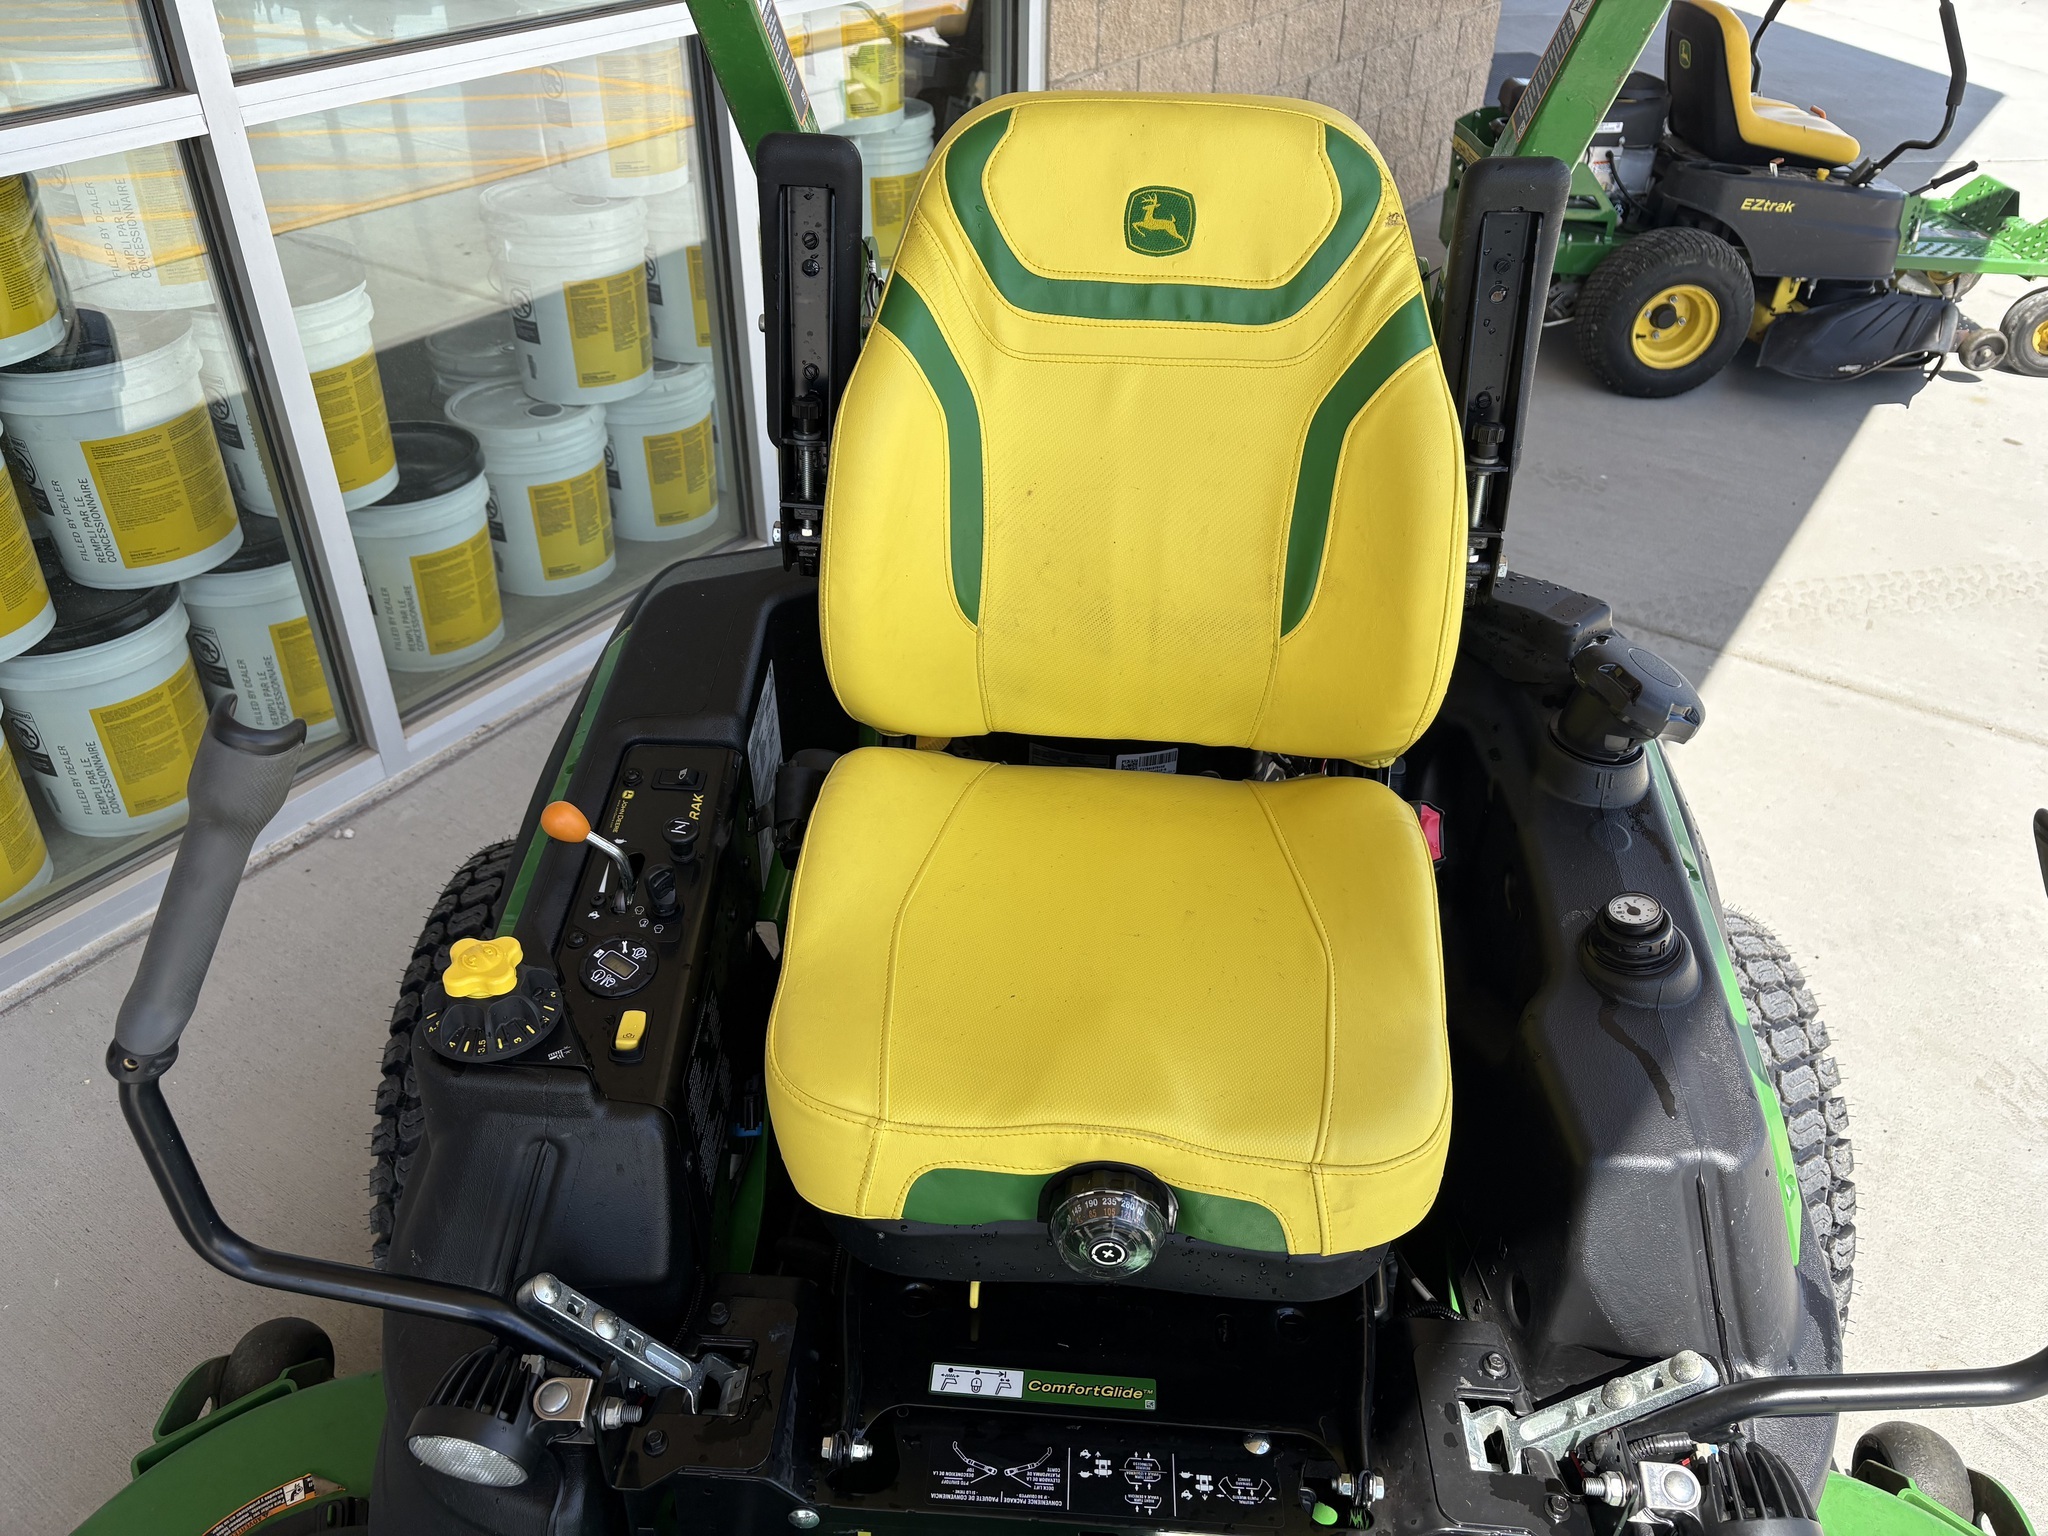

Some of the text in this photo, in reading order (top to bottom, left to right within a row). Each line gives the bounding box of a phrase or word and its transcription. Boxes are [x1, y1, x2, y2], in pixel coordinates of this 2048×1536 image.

[85, 182, 120, 278] FILLED BY DEALER
[115, 178, 152, 278] CONCESSIONNAIRE
[1740, 198, 1796, 213] EZtrak
[109, 200, 140, 278] REMPLI PAR LE
[51, 480, 90, 561] FILLED BY DEALER
[73, 497, 107, 563] REMPLI PAR LE
[78, 478, 117, 563] CONCESSIONNAIRE
[381, 587, 402, 651] FILLED BY DEALER
[398, 600, 405, 608] LE
[401, 610, 410, 624] PAR
[237, 659, 264, 726] FILLED BY DEALER
[257, 671, 266, 680] LE
[261, 683, 272, 697] PAR
[57, 745, 92, 815] FILLED BY DEALER
[80, 758, 110, 815] REMPLI PAR LE
[85, 741, 121, 814] CONCESSIONNAIRE
[612, 800, 628, 833] JOHN DEERE
[478, 1040, 486, 1053] 3.5
[1072, 1204, 1082, 1216] 145
[1085, 1198, 1098, 1208] 190
[1102, 1198, 1117, 1206] 235
[1104, 1208, 1116, 1216] 105
